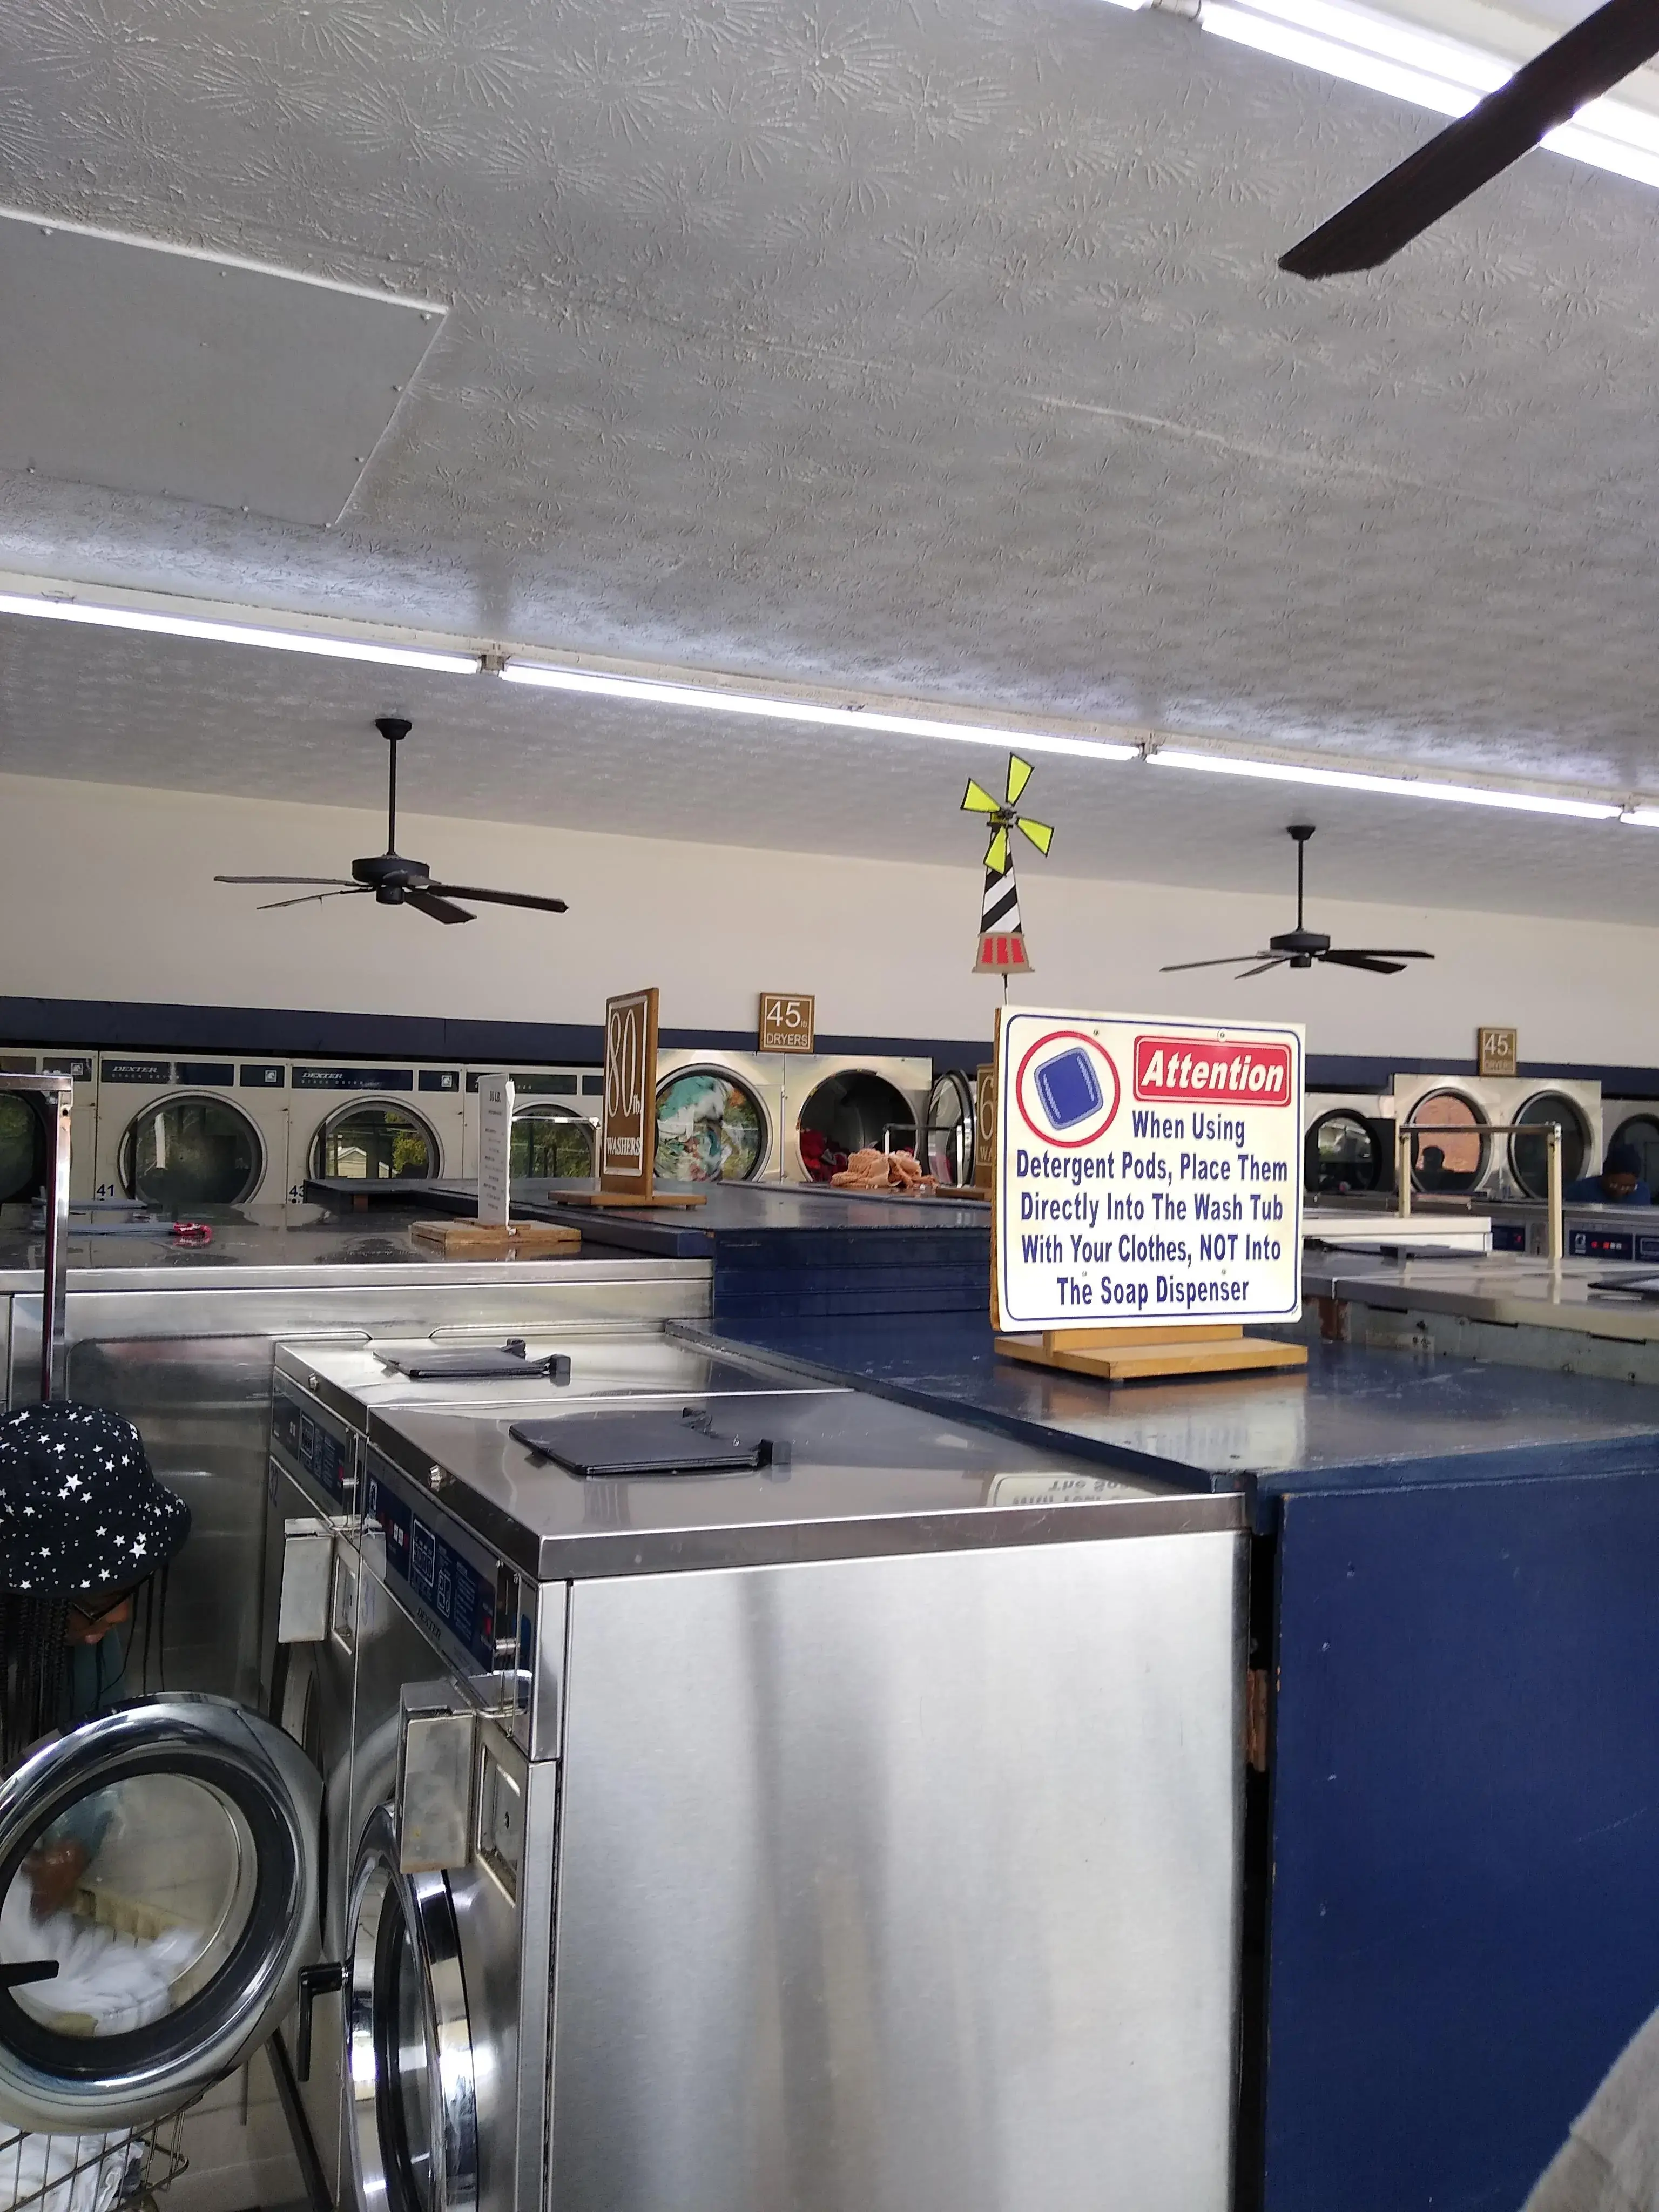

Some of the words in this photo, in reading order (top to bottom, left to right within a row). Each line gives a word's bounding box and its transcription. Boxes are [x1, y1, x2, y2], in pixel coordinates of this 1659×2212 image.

[767, 1001, 801, 1028] 45
[767, 1032, 808, 1046] DRYERS
[1484, 1034, 1508, 1056] 45
[608, 1008, 636, 1118] 80
[1140, 1049, 1285, 1093] Attention
[980, 1075, 994, 1141] 6
[1132, 1110, 1184, 1139] When
[1192, 1112, 1245, 1147] Using
[606, 1137, 641, 1156] WASHERS
[1017, 1149, 1114, 1185] Detergent
[1122, 1151, 1172, 1187] Pods,
[1181, 1154, 1230, 1181] Place
[1238, 1154, 1287, 1181] Them
[97, 1184, 114, 1197] 41
[1021, 1192, 1099, 1228] Directly
[1107, 1192, 1144, 1220] Into
[1152, 1193, 1186, 1220] The
[1194, 1193, 1242, 1220] Wash
[1250, 1194, 1283, 1220] Tub
[1022, 1234, 1063, 1263] With
[1071, 1234, 1112, 1263] Your
[1118, 1234, 1192, 1268] Clothes,
[1200, 1235, 1238, 1262] NOT
[1246, 1235, 1281, 1260] Into
[1057, 1277, 1092, 1305] The
[1101, 1276, 1148, 1310] Soap
[1156, 1276, 1249, 1309] Dispenser
